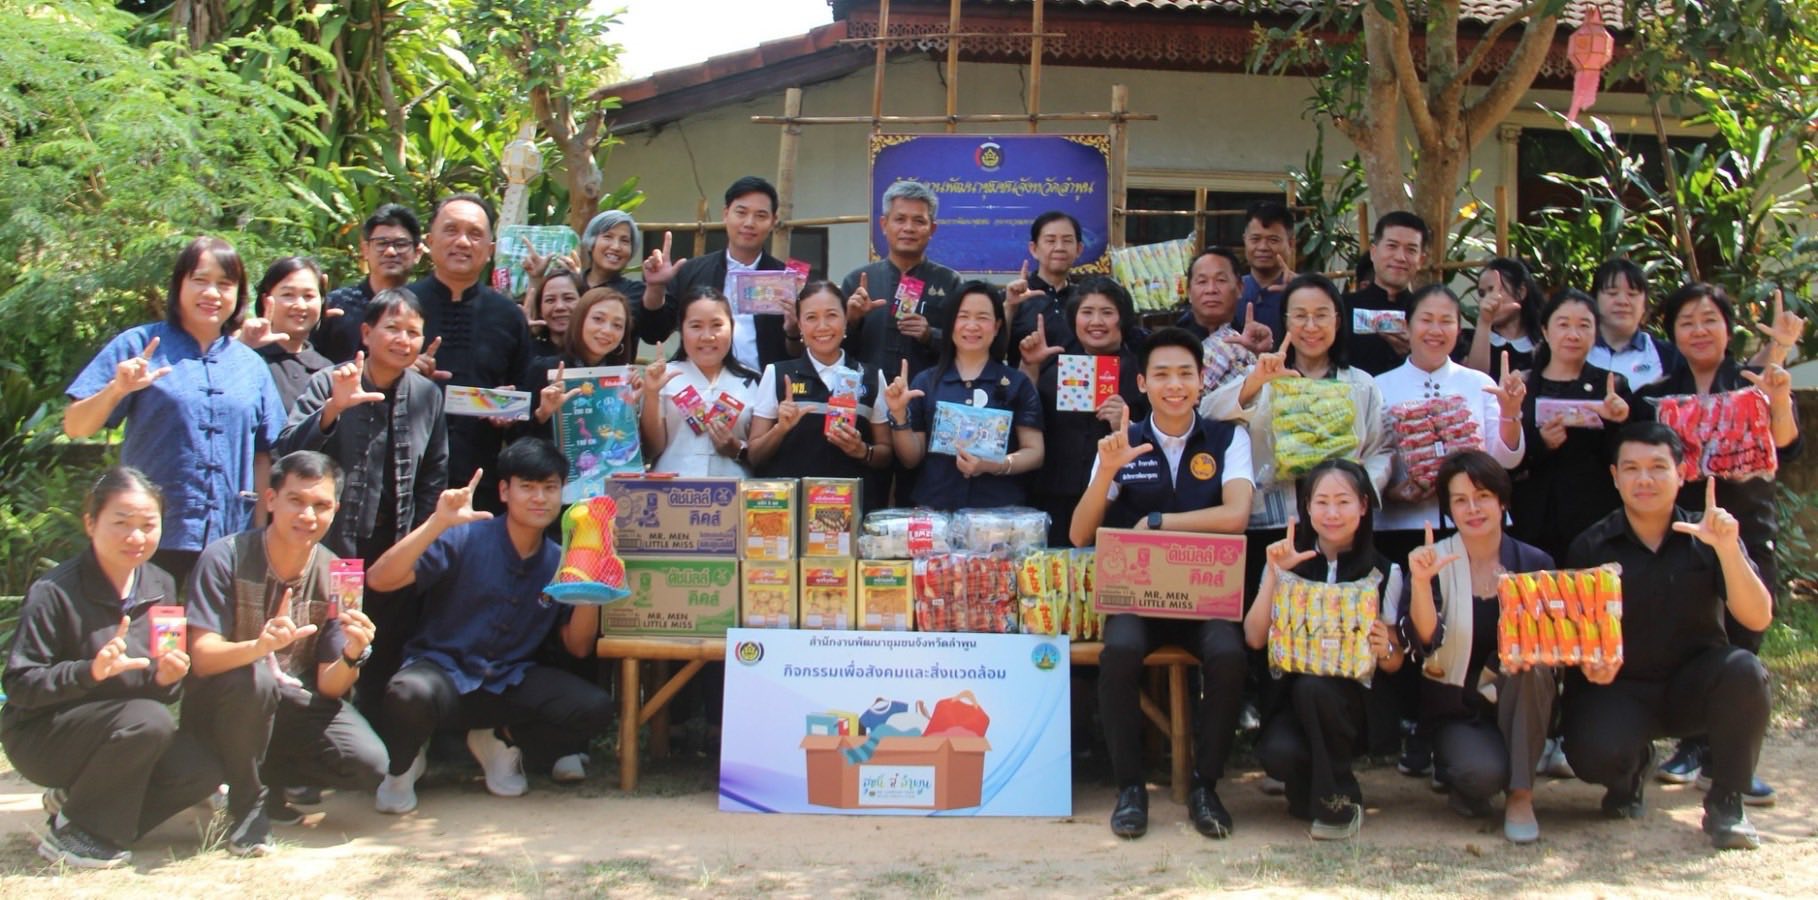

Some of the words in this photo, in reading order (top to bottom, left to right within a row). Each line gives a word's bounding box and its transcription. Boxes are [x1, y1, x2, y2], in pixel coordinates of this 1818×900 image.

[1099, 384, 1114, 395] 24
[649, 532, 666, 541] MR.
[669, 532, 690, 540] MEN
[645, 540, 669, 549] LITTLE
[672, 541, 695, 549] MISS
[1144, 590, 1162, 599] MR.
[1166, 591, 1189, 600] MEN
[1139, 599, 1166, 608] LITTLE
[1169, 600, 1193, 609] MISS
[648, 612, 665, 620] MR.
[668, 612, 689, 620] MEN
[643, 620, 668, 629] LITTLE
[671, 621, 694, 629] MISS
[809, 635, 977, 651] สำนักงานพัฒนาชุมชนจังหวัดลำพูน
[783, 660, 1006, 680] กิจกรรมเพื่อสังคมและสิ่งแวดล้อม
